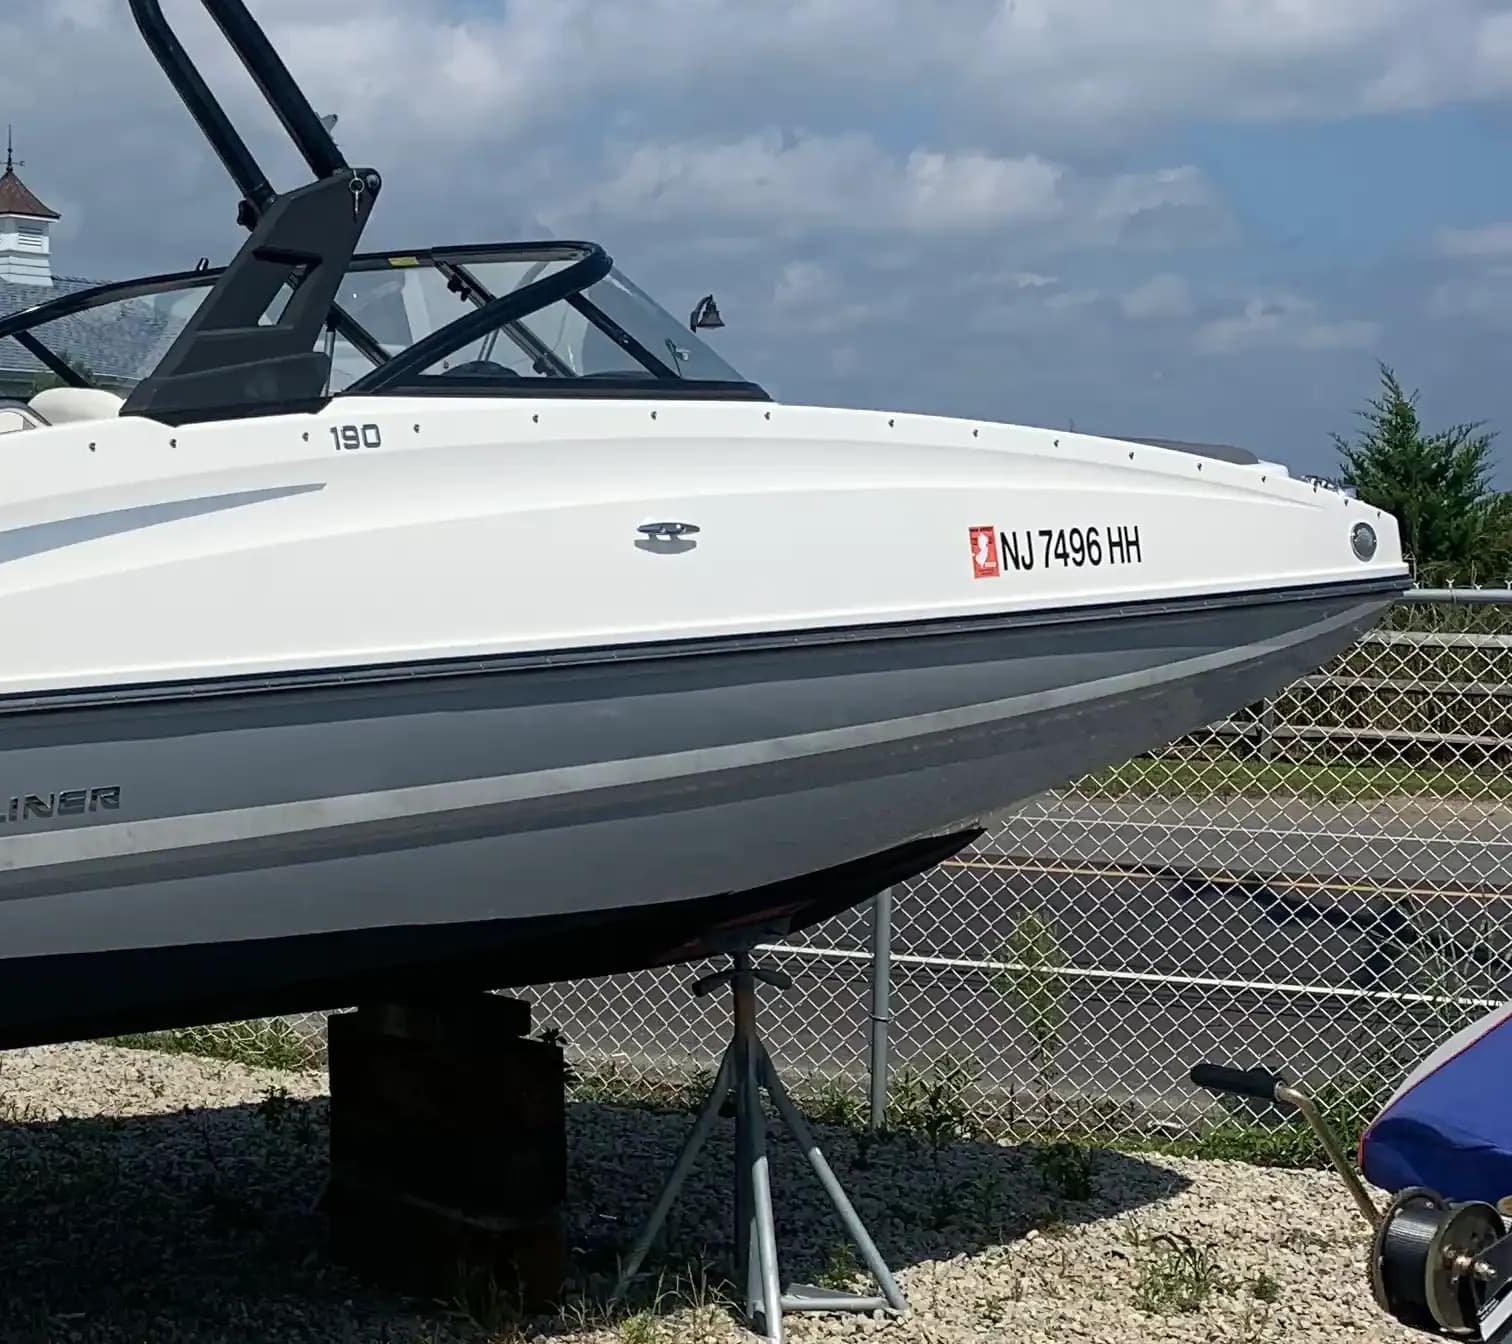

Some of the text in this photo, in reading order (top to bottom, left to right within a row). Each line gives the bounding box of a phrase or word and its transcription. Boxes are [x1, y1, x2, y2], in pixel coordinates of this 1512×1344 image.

[329, 423, 381, 450] 190
[1000, 525, 1142, 571] NJ 7496 HH
